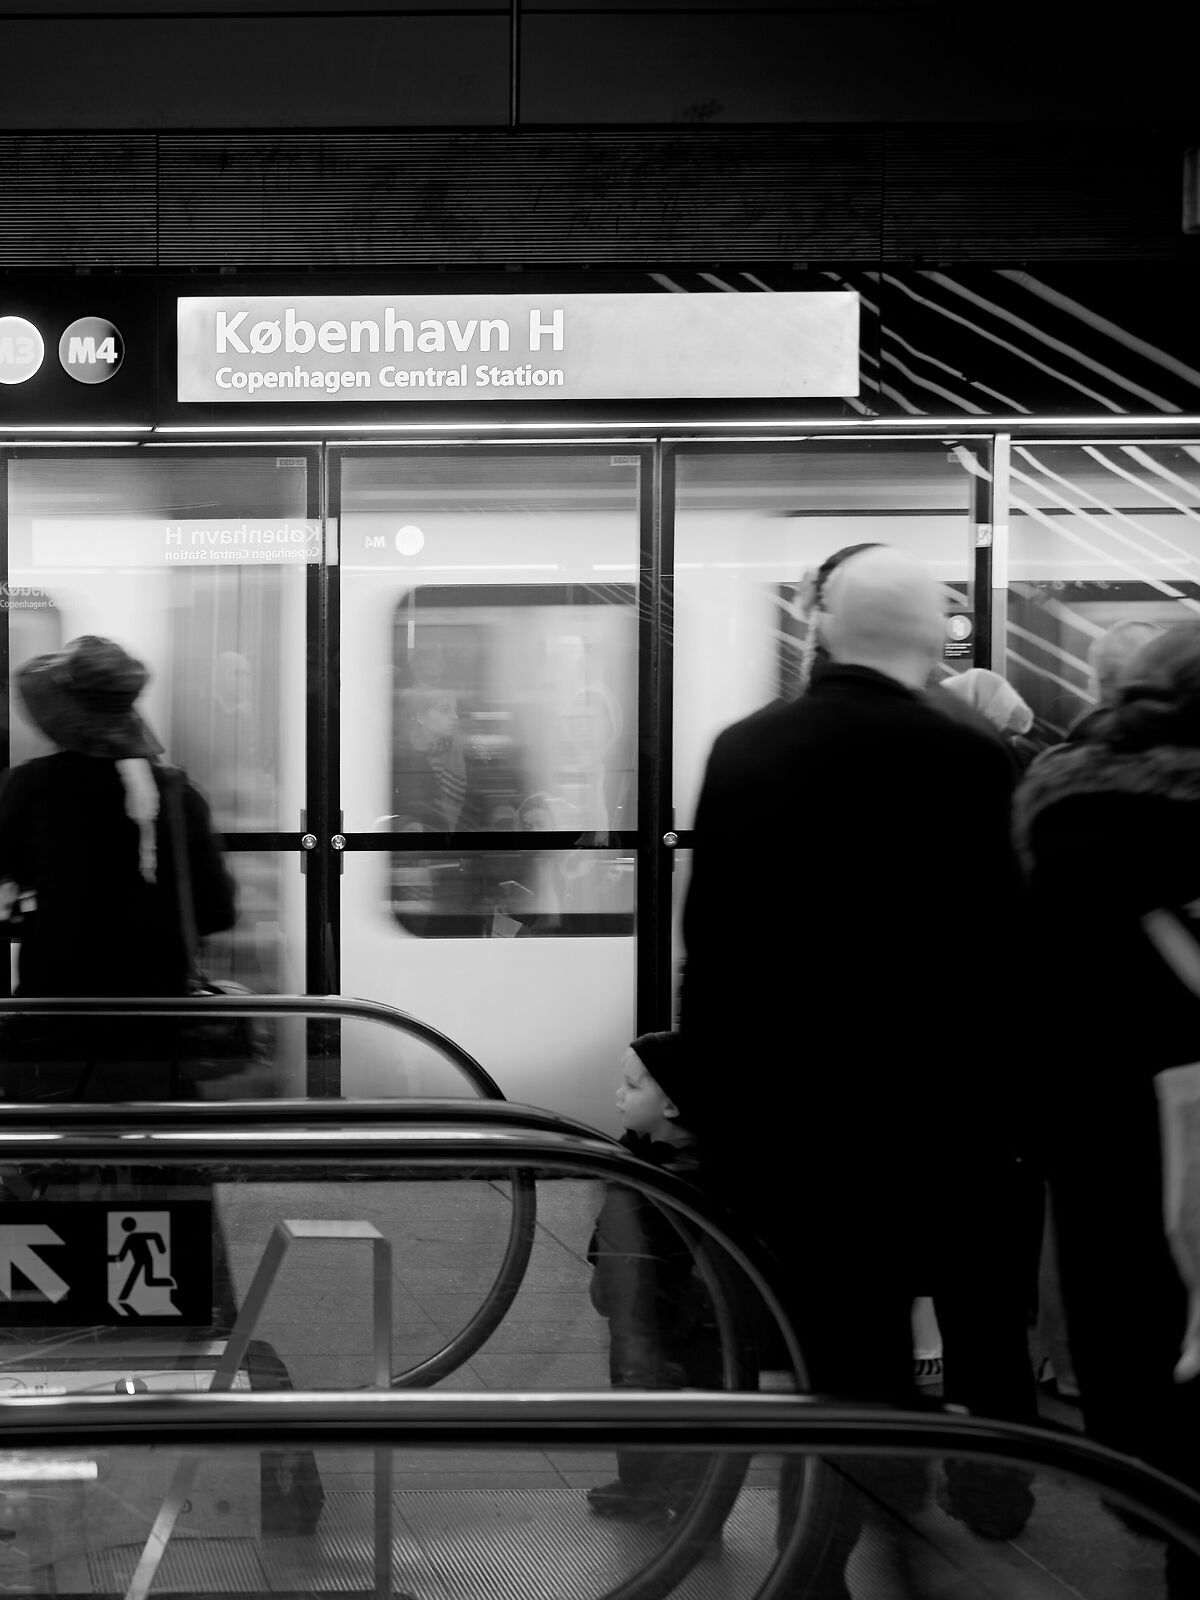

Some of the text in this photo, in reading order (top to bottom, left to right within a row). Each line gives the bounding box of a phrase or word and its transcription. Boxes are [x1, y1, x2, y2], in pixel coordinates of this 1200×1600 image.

[215, 307, 565, 355] København H
[68, 336, 117, 364] M4
[215, 364, 564, 393] Copenhagen Central Station
